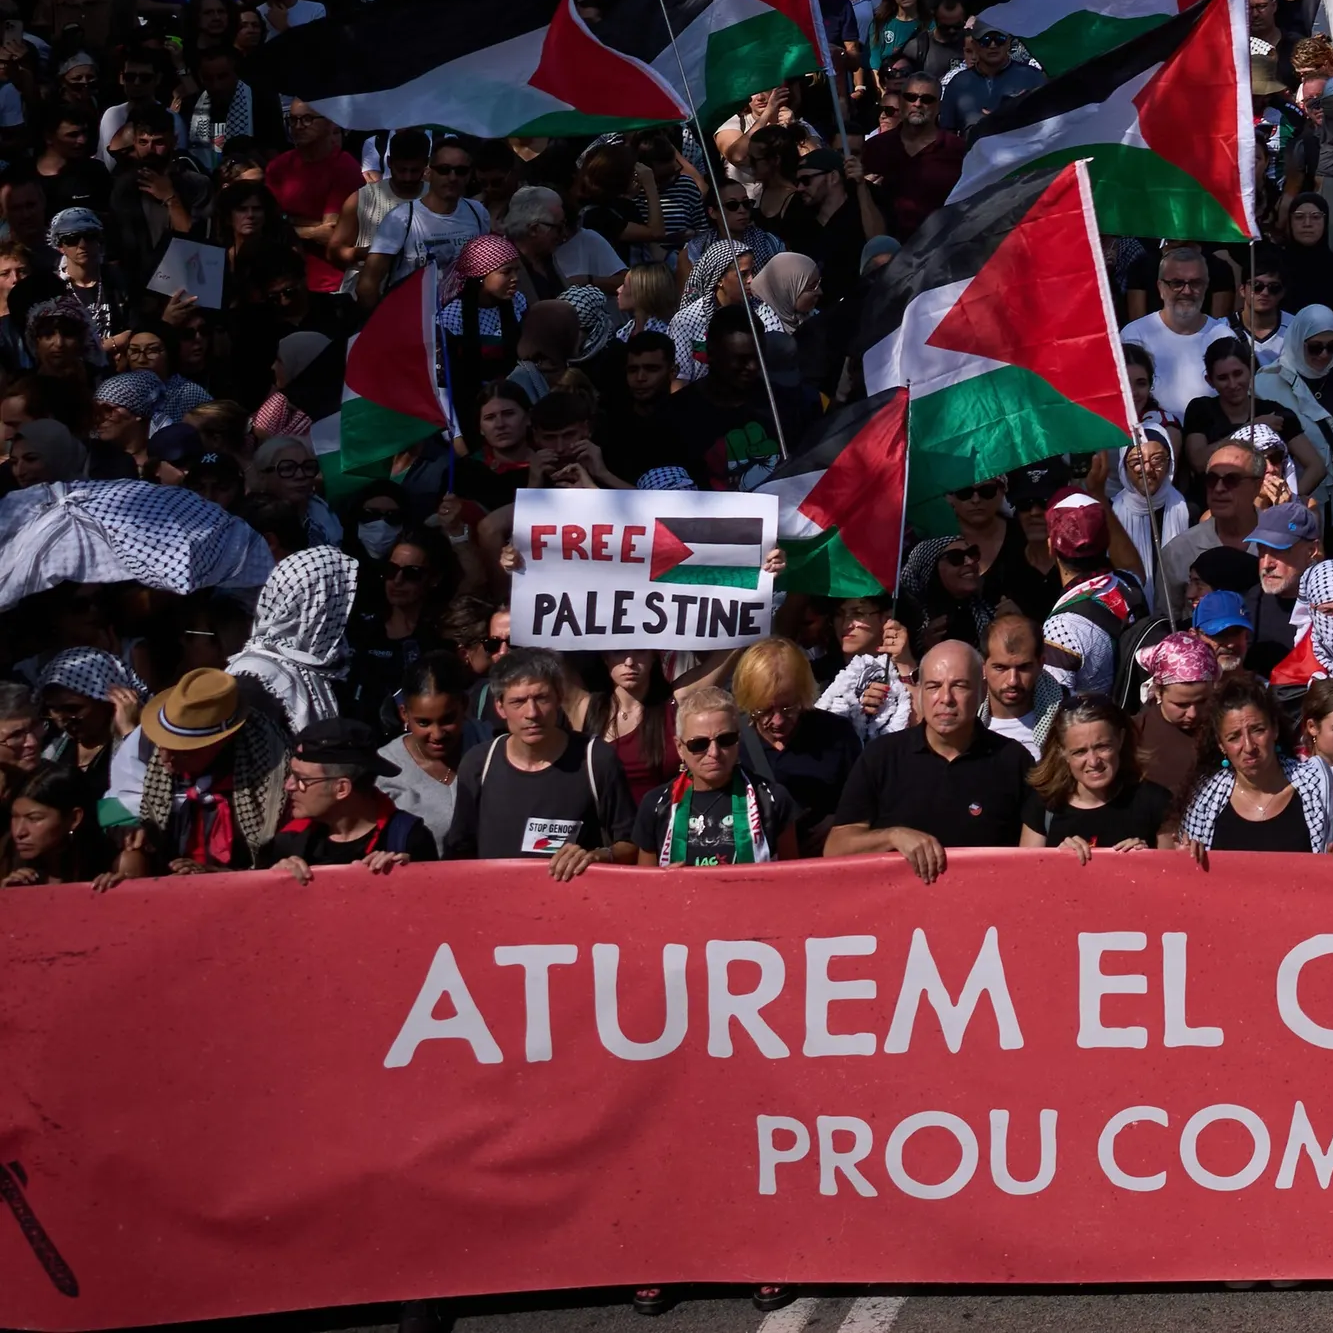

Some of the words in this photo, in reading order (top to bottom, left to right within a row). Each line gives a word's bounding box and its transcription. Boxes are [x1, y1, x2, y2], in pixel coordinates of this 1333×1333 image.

[531, 524, 646, 563] FREE
[532, 590, 765, 639] PALESTINE
[529, 822, 547, 834] STOP
[384, 926, 1024, 1068] ATUREM
[1077, 931, 1224, 1049] EL
[756, 1109, 1058, 1197] PROU
